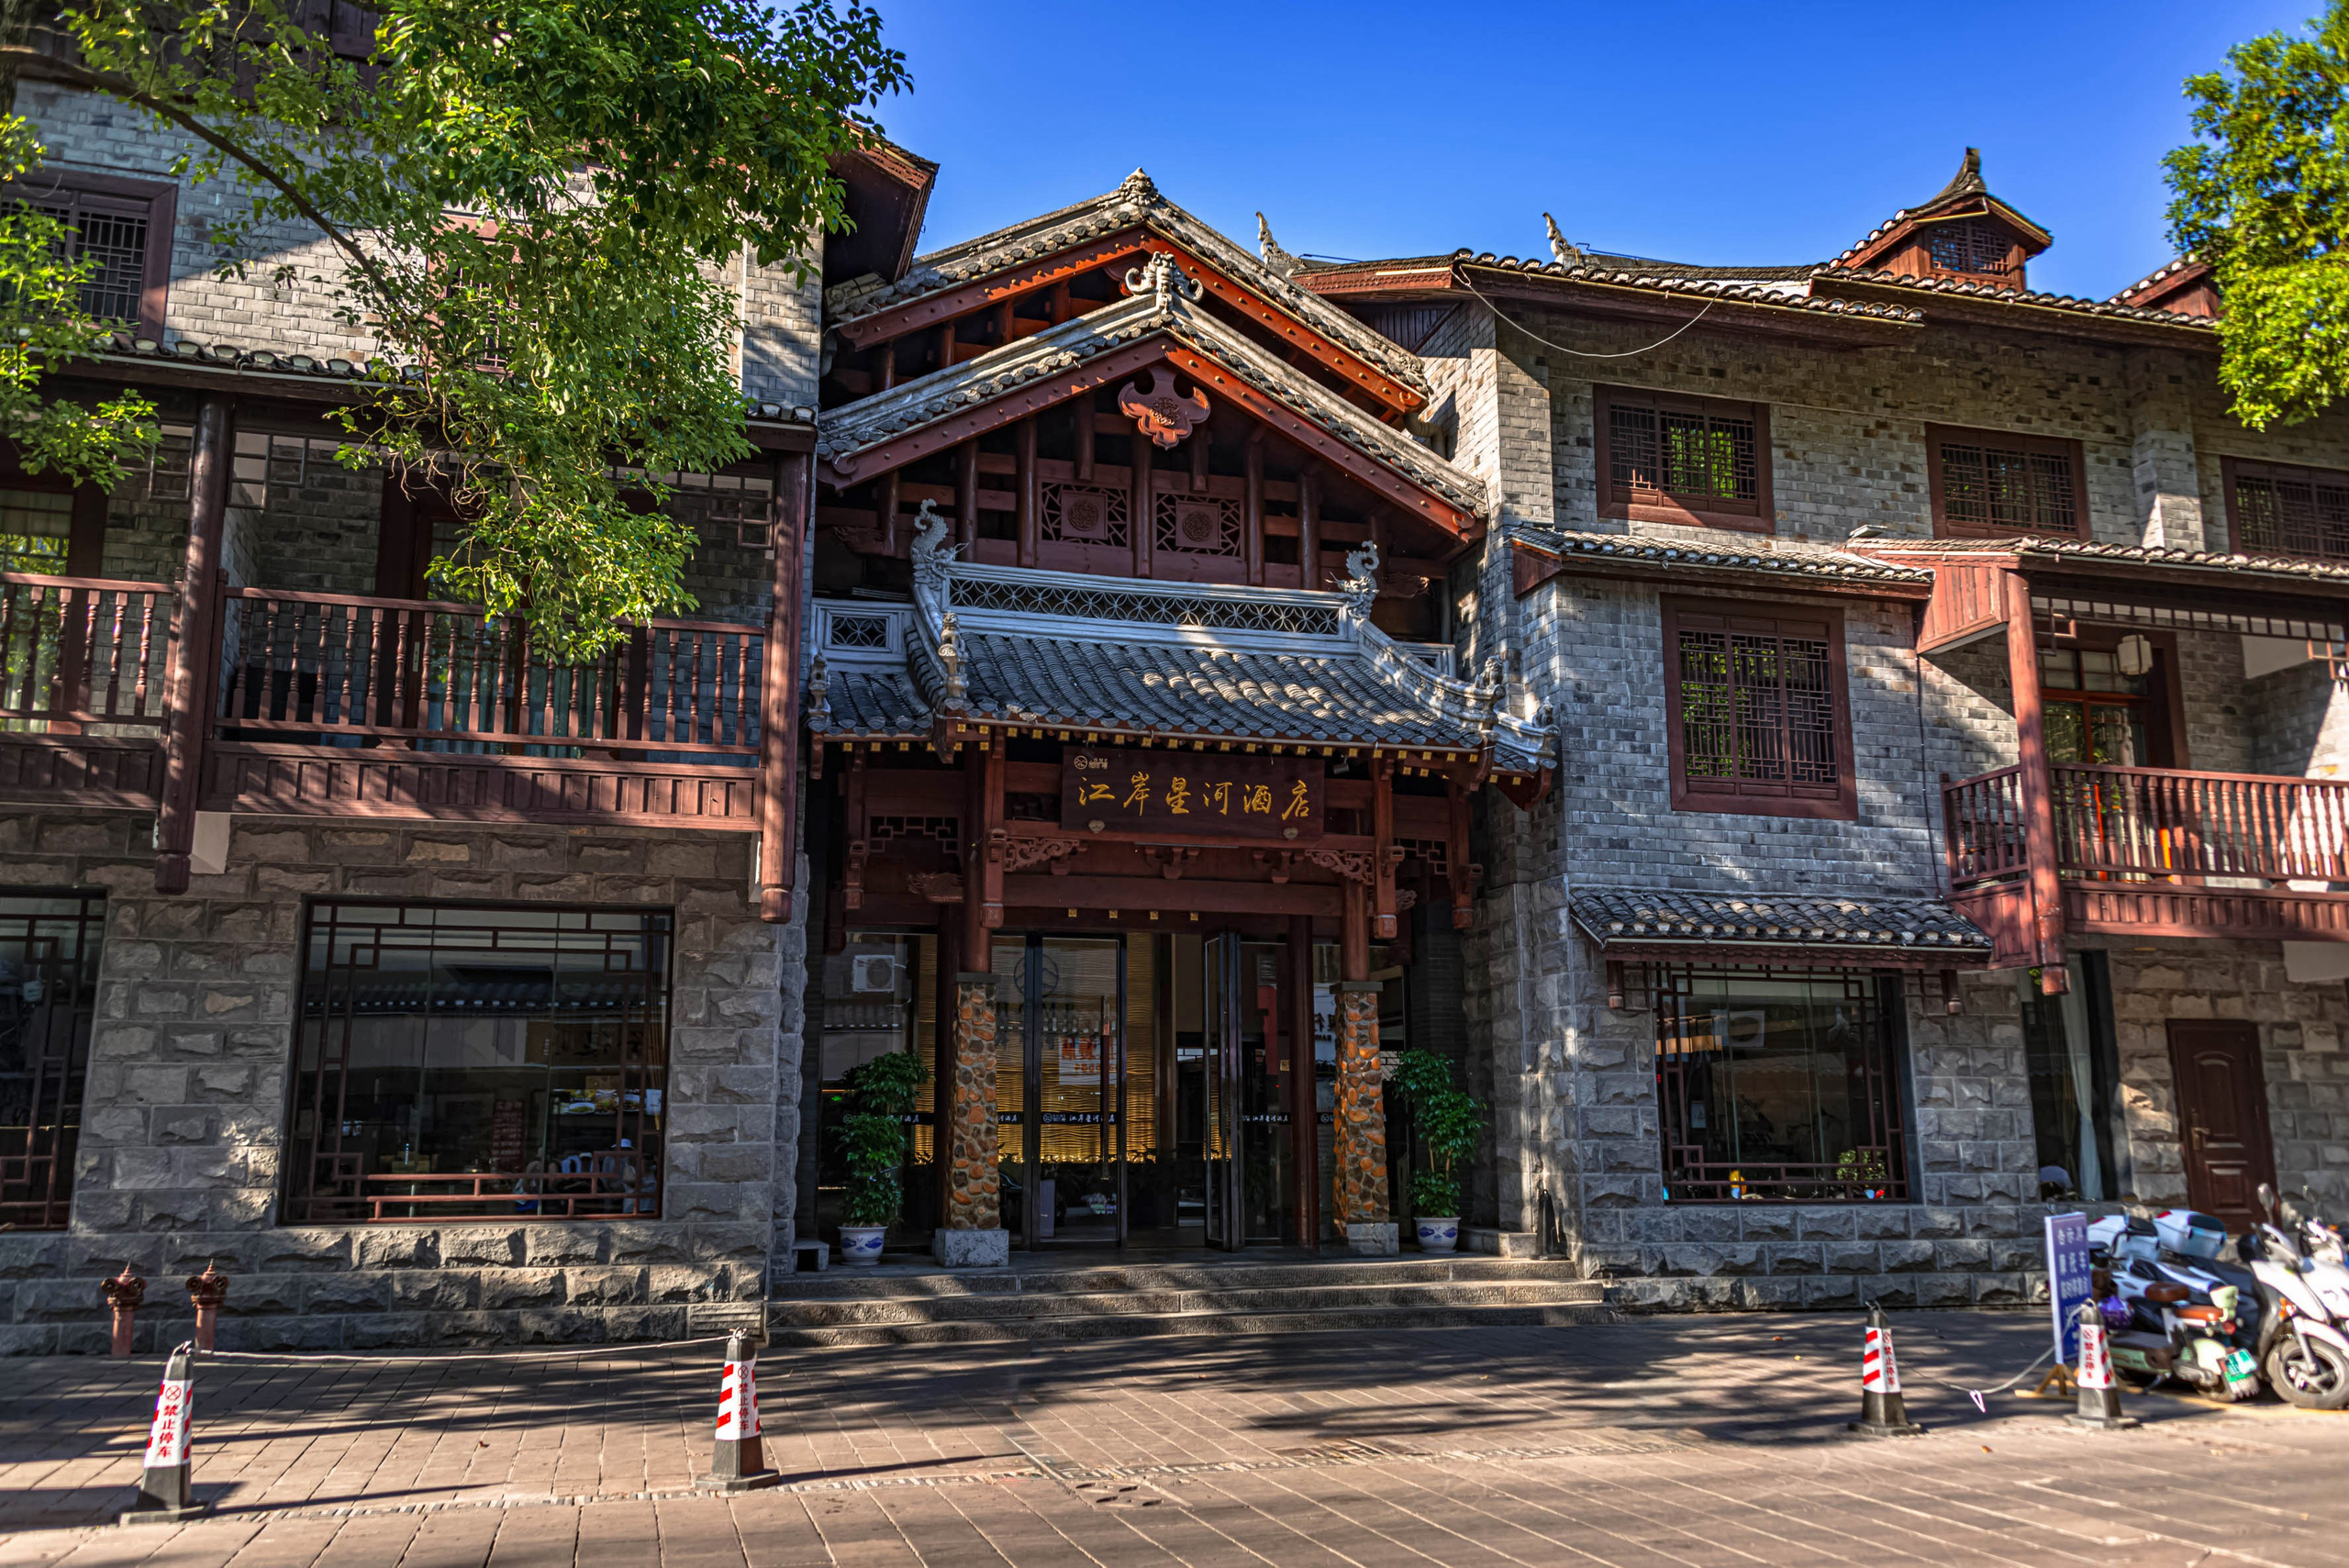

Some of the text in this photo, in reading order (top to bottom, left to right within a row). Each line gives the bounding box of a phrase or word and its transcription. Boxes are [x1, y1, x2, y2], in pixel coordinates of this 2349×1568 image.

[1078, 771, 1310, 820] 江岸星河酒店
[1069, 1113, 1115, 1123] 江岸星河店
[739, 1383, 749, 1430] 禁止停车
[157, 1405, 178, 1458] 禁止停车
